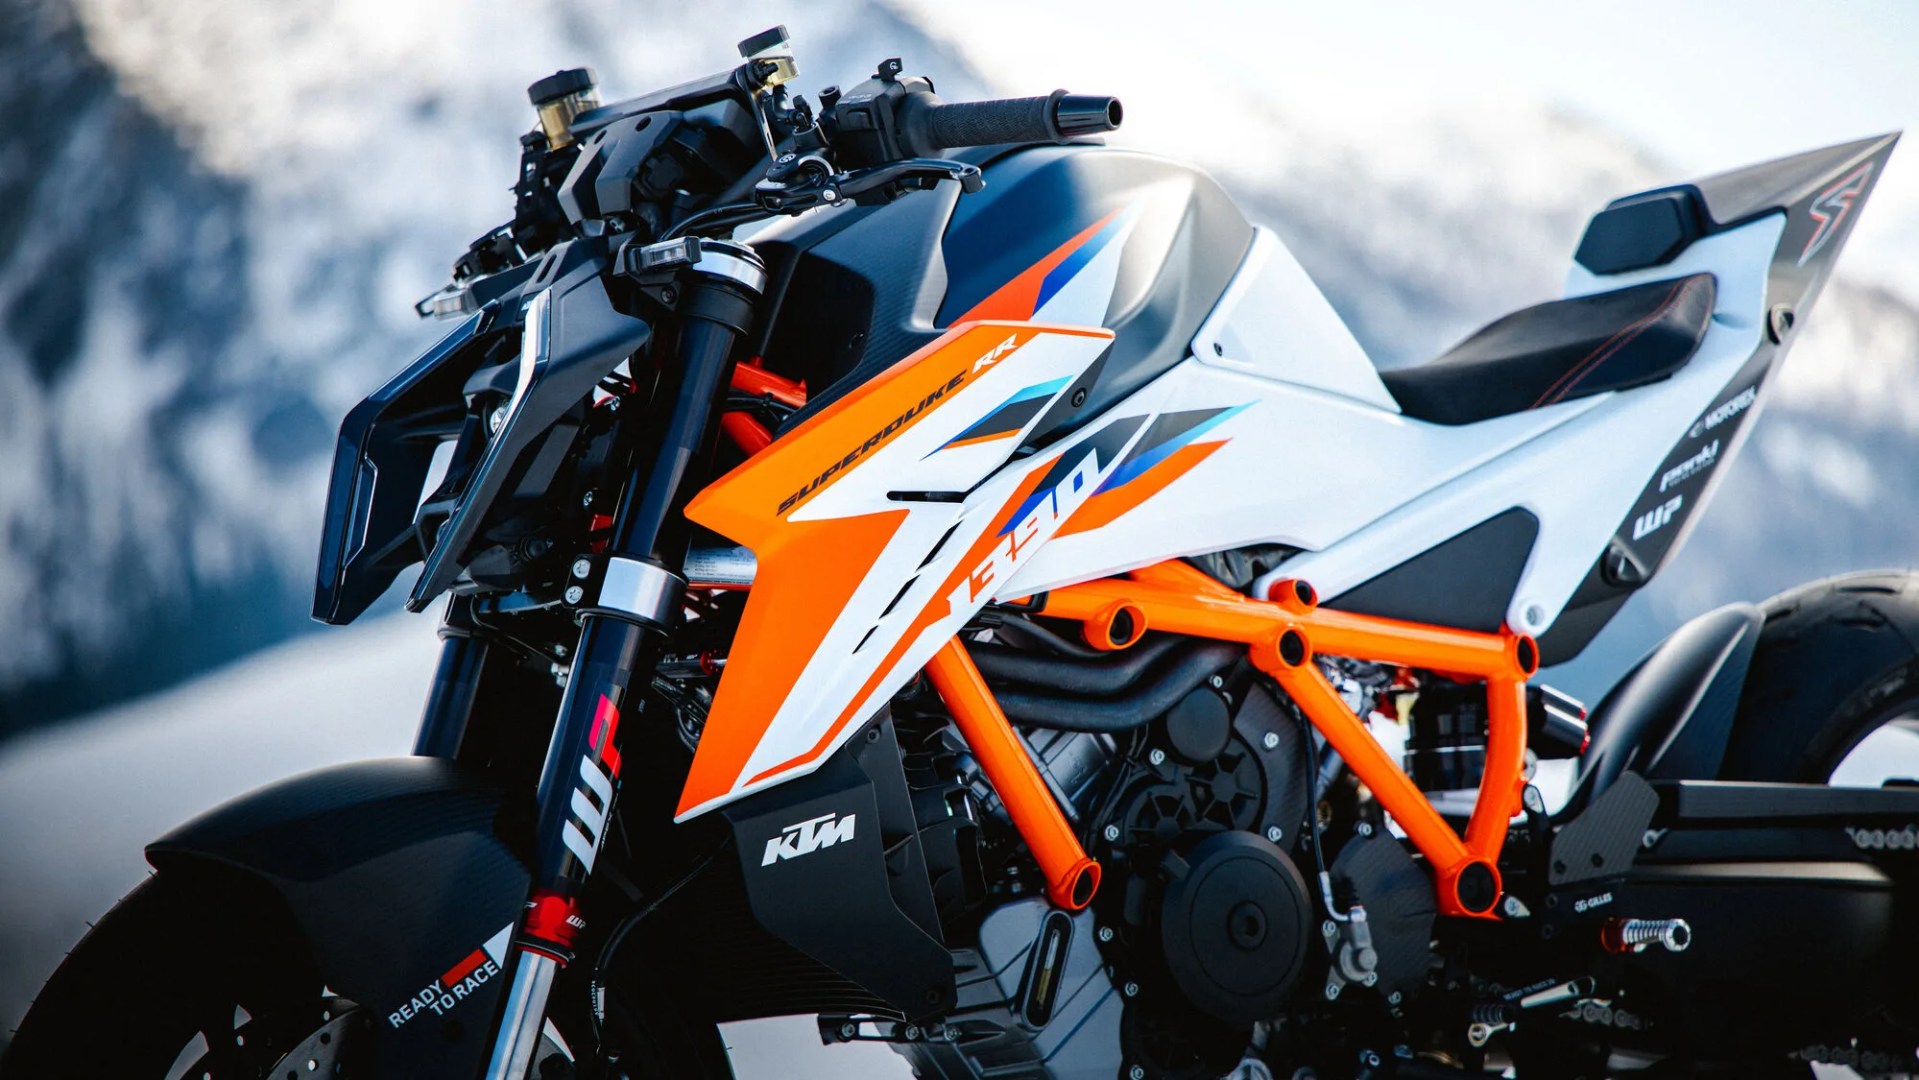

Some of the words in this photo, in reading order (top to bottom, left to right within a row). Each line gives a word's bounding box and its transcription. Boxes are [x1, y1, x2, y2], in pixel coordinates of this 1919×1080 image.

[777, 369, 967, 517] SUPERDUKE
[972, 333, 1018, 375] RR
[946, 447, 1100, 617] 1390
[1632, 494, 1683, 541] WP
[562, 694, 621, 876] WP
[761, 812, 856, 867] KTM
[388, 979, 444, 1029] READY
[429, 992, 455, 1016] TO
[452, 959, 499, 1000] RACE
